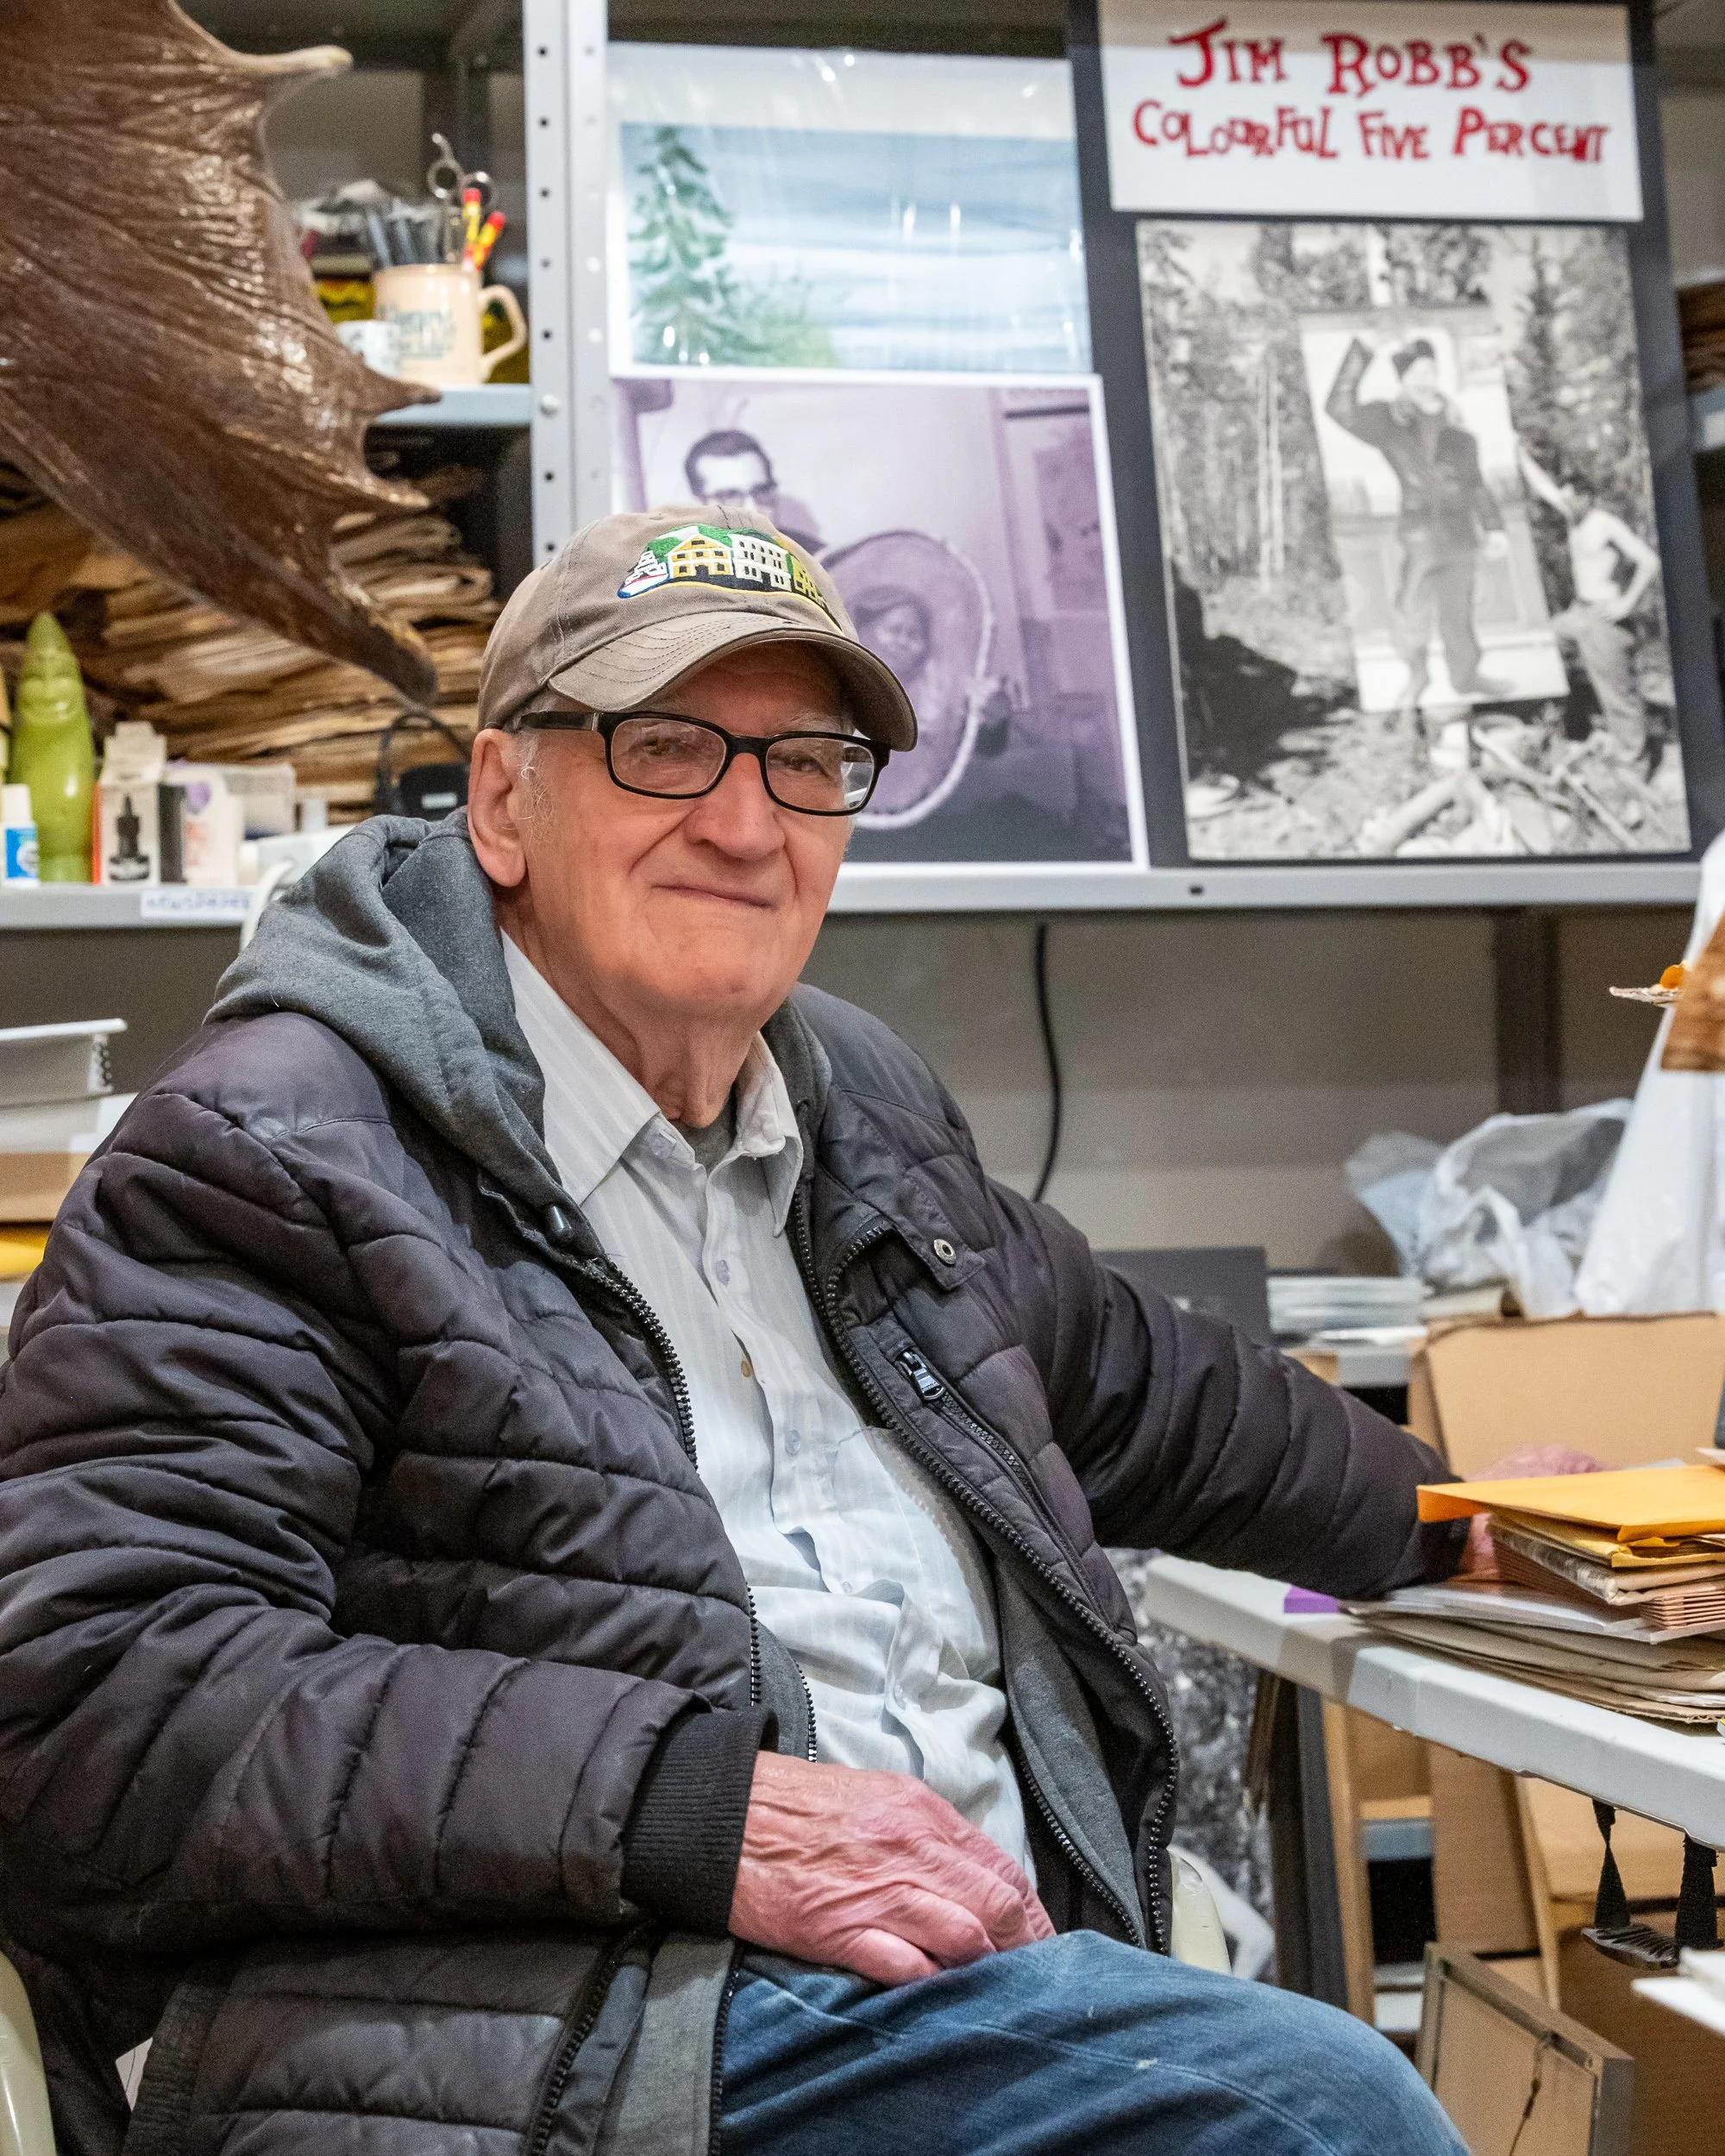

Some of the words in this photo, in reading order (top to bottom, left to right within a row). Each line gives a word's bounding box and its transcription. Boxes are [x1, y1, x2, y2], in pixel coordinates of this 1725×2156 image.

[1168, 19, 1287, 91] JIM
[1320, 33, 1531, 97] ROBB'S
[1358, 112, 1430, 160] FIVE
[1452, 107, 1609, 163] PERCENT
